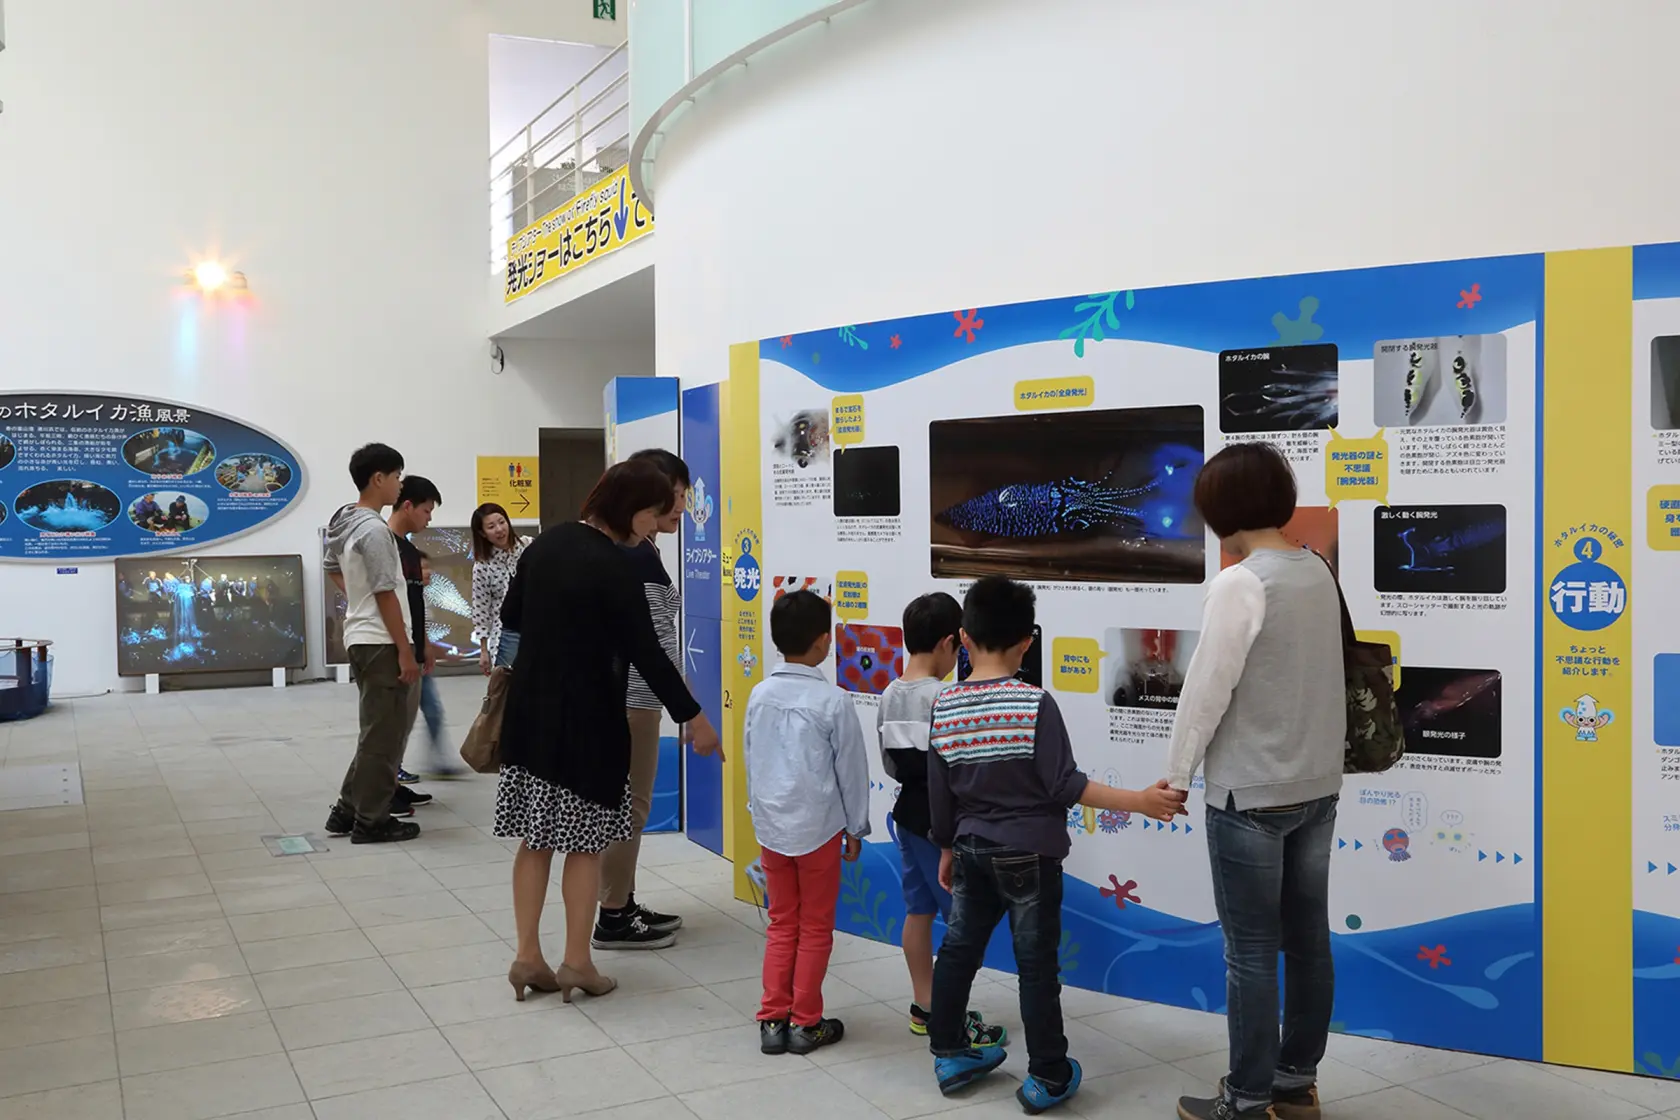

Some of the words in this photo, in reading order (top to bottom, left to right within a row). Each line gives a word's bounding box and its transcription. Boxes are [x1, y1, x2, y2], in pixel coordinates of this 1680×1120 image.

[506, 206, 611, 295] 発光ショーはこちら
[1553, 523, 1625, 549] ホタルイカの秘密
[743, 539, 750, 553] 3
[1581, 541, 1593, 559] 4
[734, 567, 761, 589] 発光
[1551, 580, 1626, 614] 行動
[1569, 645, 1606, 654] ちょっと
[1555, 655, 1621, 666] 不思議な行動を
[1562, 666, 1613, 677] 紹介します。
